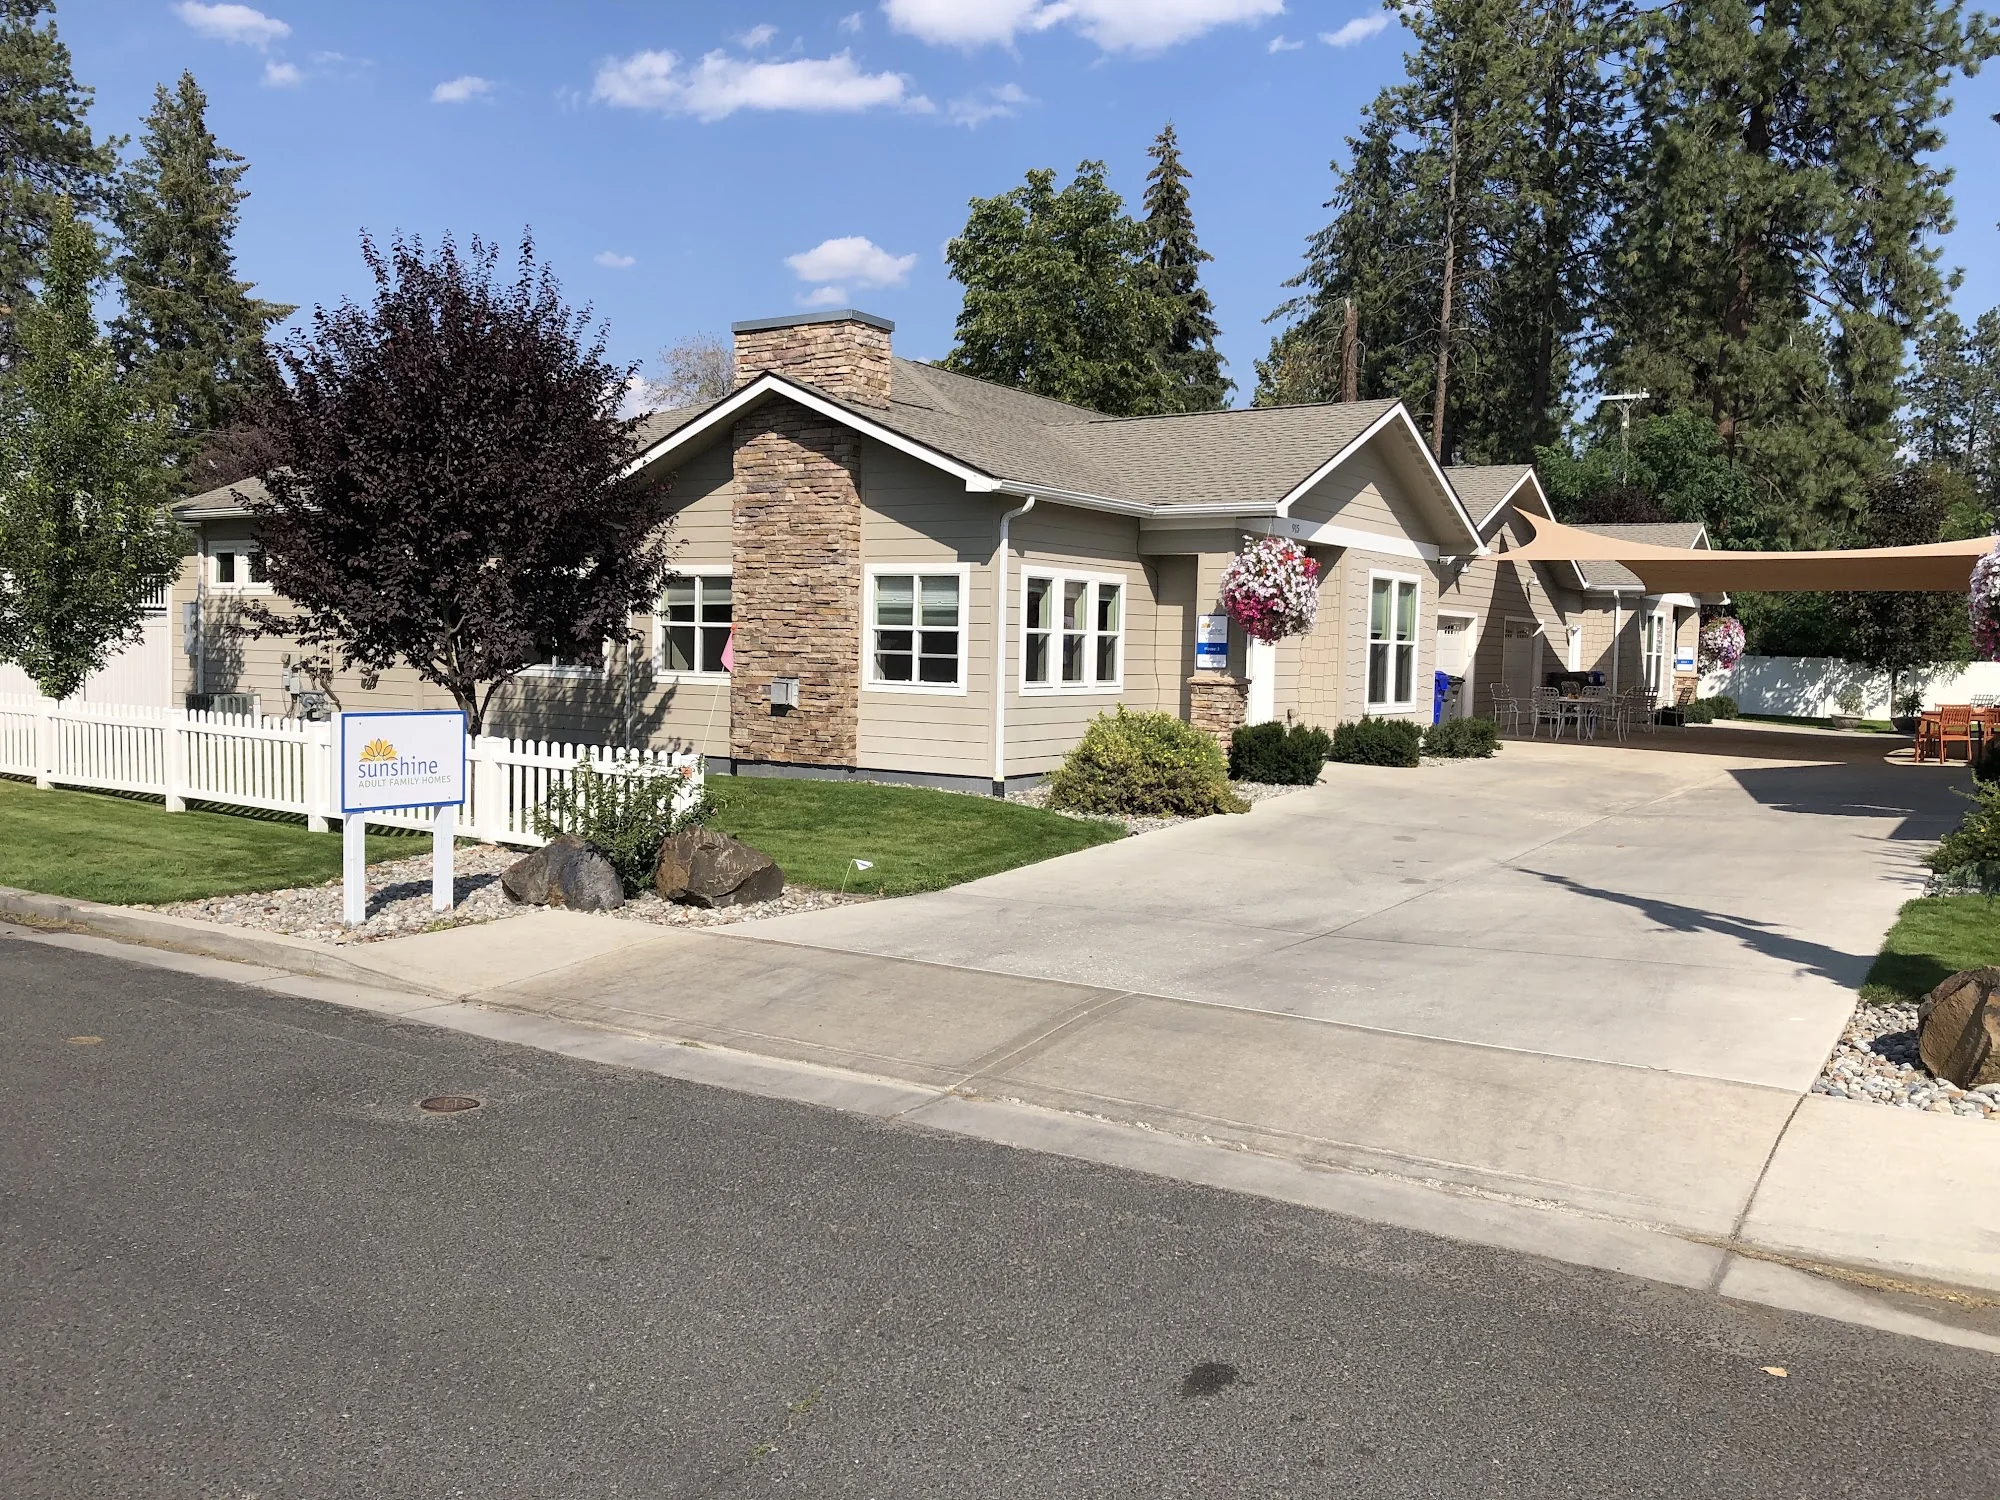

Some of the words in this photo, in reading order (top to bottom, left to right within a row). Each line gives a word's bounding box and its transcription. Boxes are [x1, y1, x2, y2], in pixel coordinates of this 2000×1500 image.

[358, 756, 438, 778] sunshine
[358, 779, 386, 788] ADULT
[389, 777, 420, 787] FAMILY
[422, 775, 451, 784] HOMES
